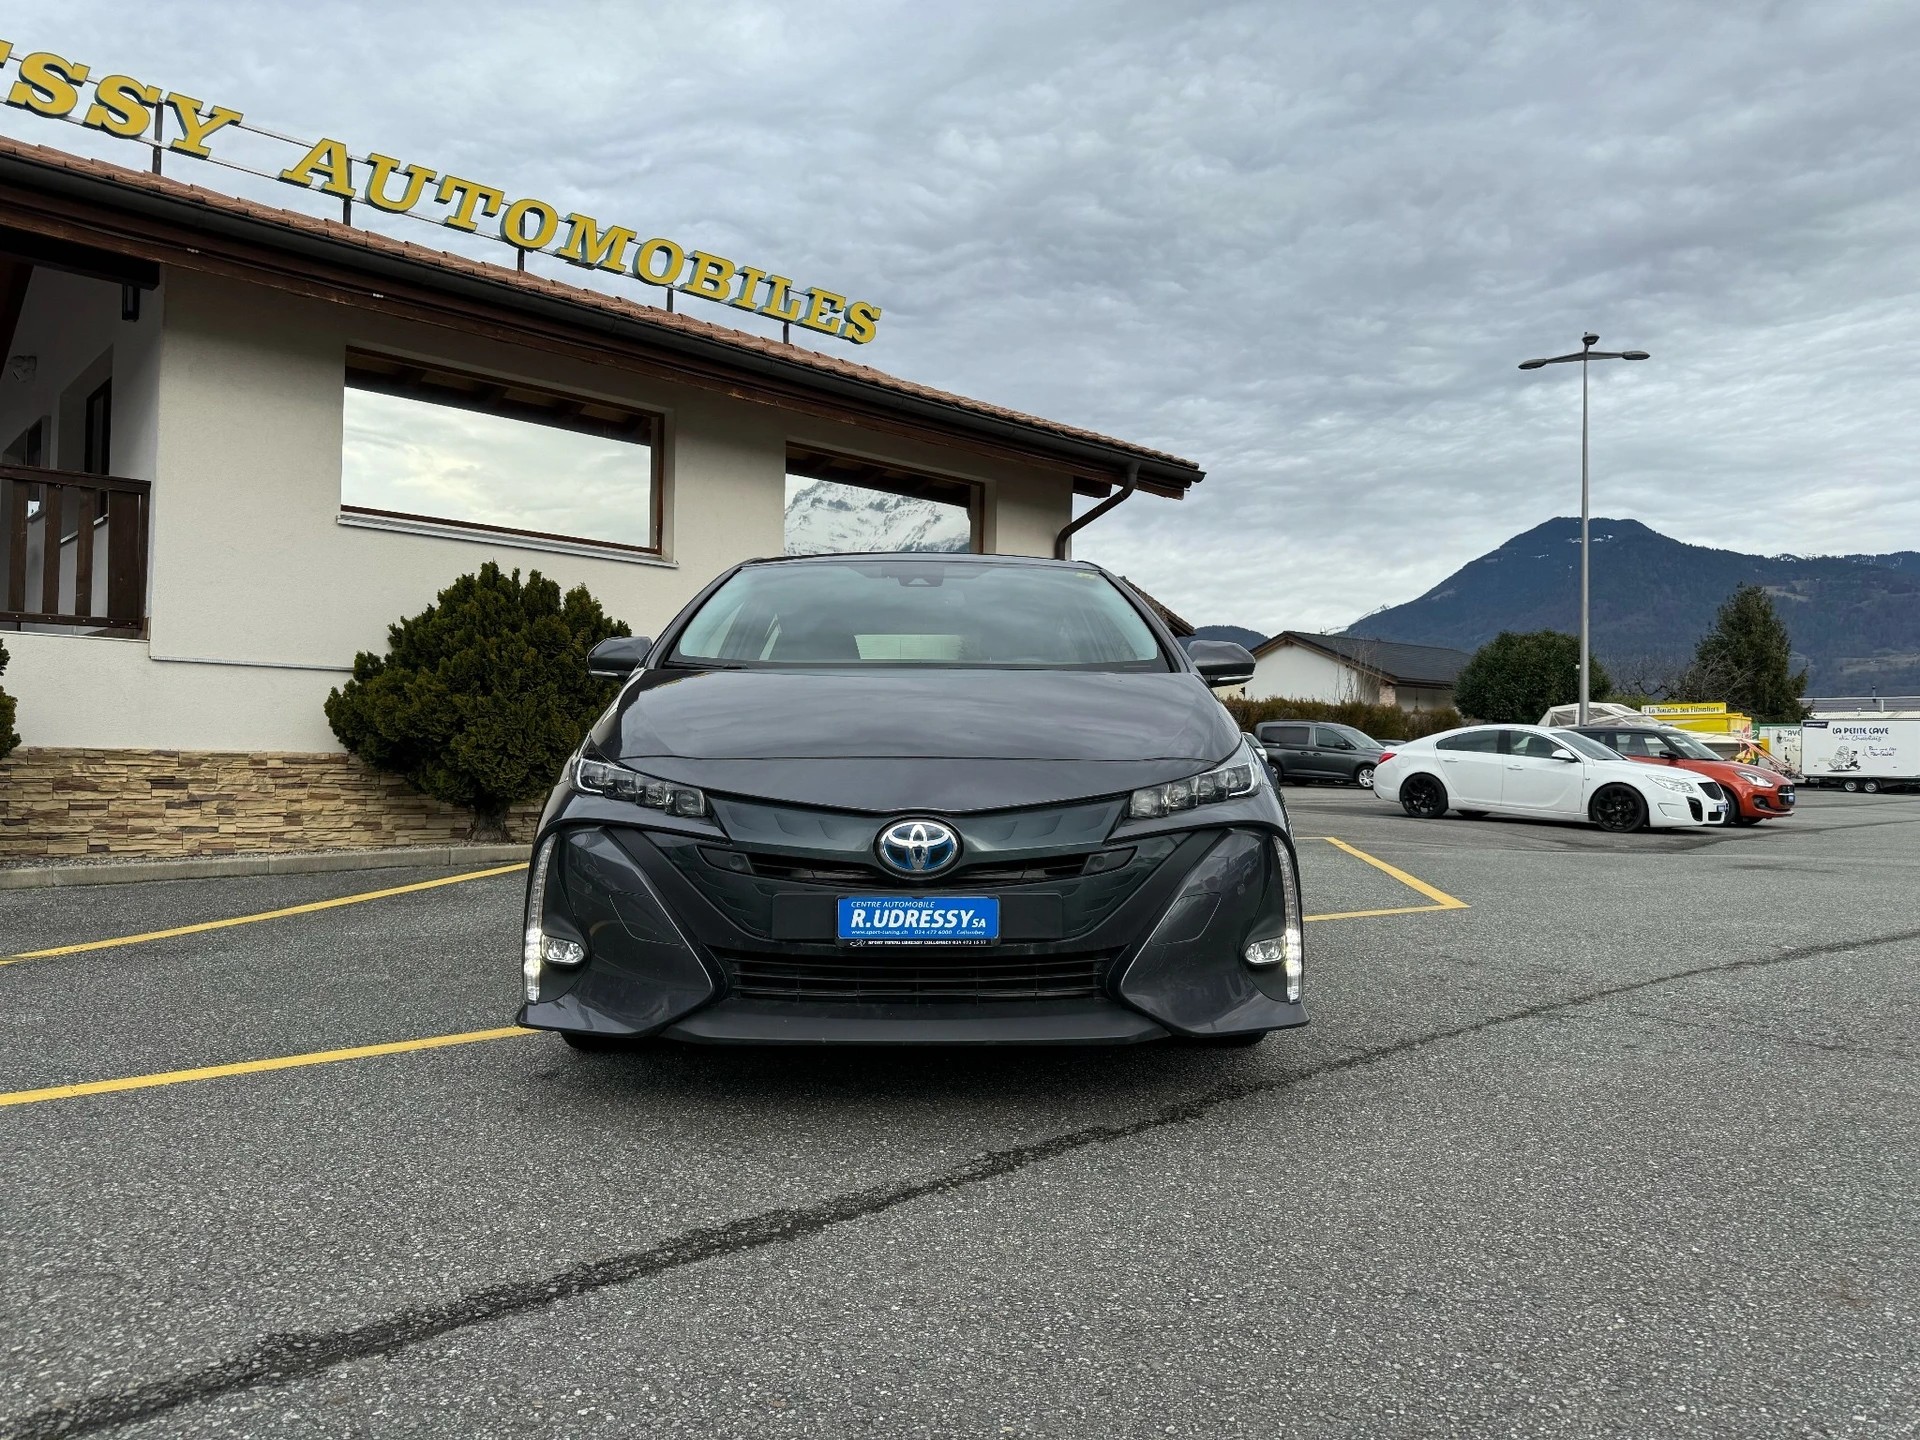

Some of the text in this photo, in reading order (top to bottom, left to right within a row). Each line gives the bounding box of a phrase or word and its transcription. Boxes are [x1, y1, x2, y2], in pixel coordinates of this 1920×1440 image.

[0, 40, 882, 345] SSY AUTOMOBILES
[1832, 727, 1889, 735] LA PETITE CAVE
[851, 909, 986, 928] R.UDRESSY SA
